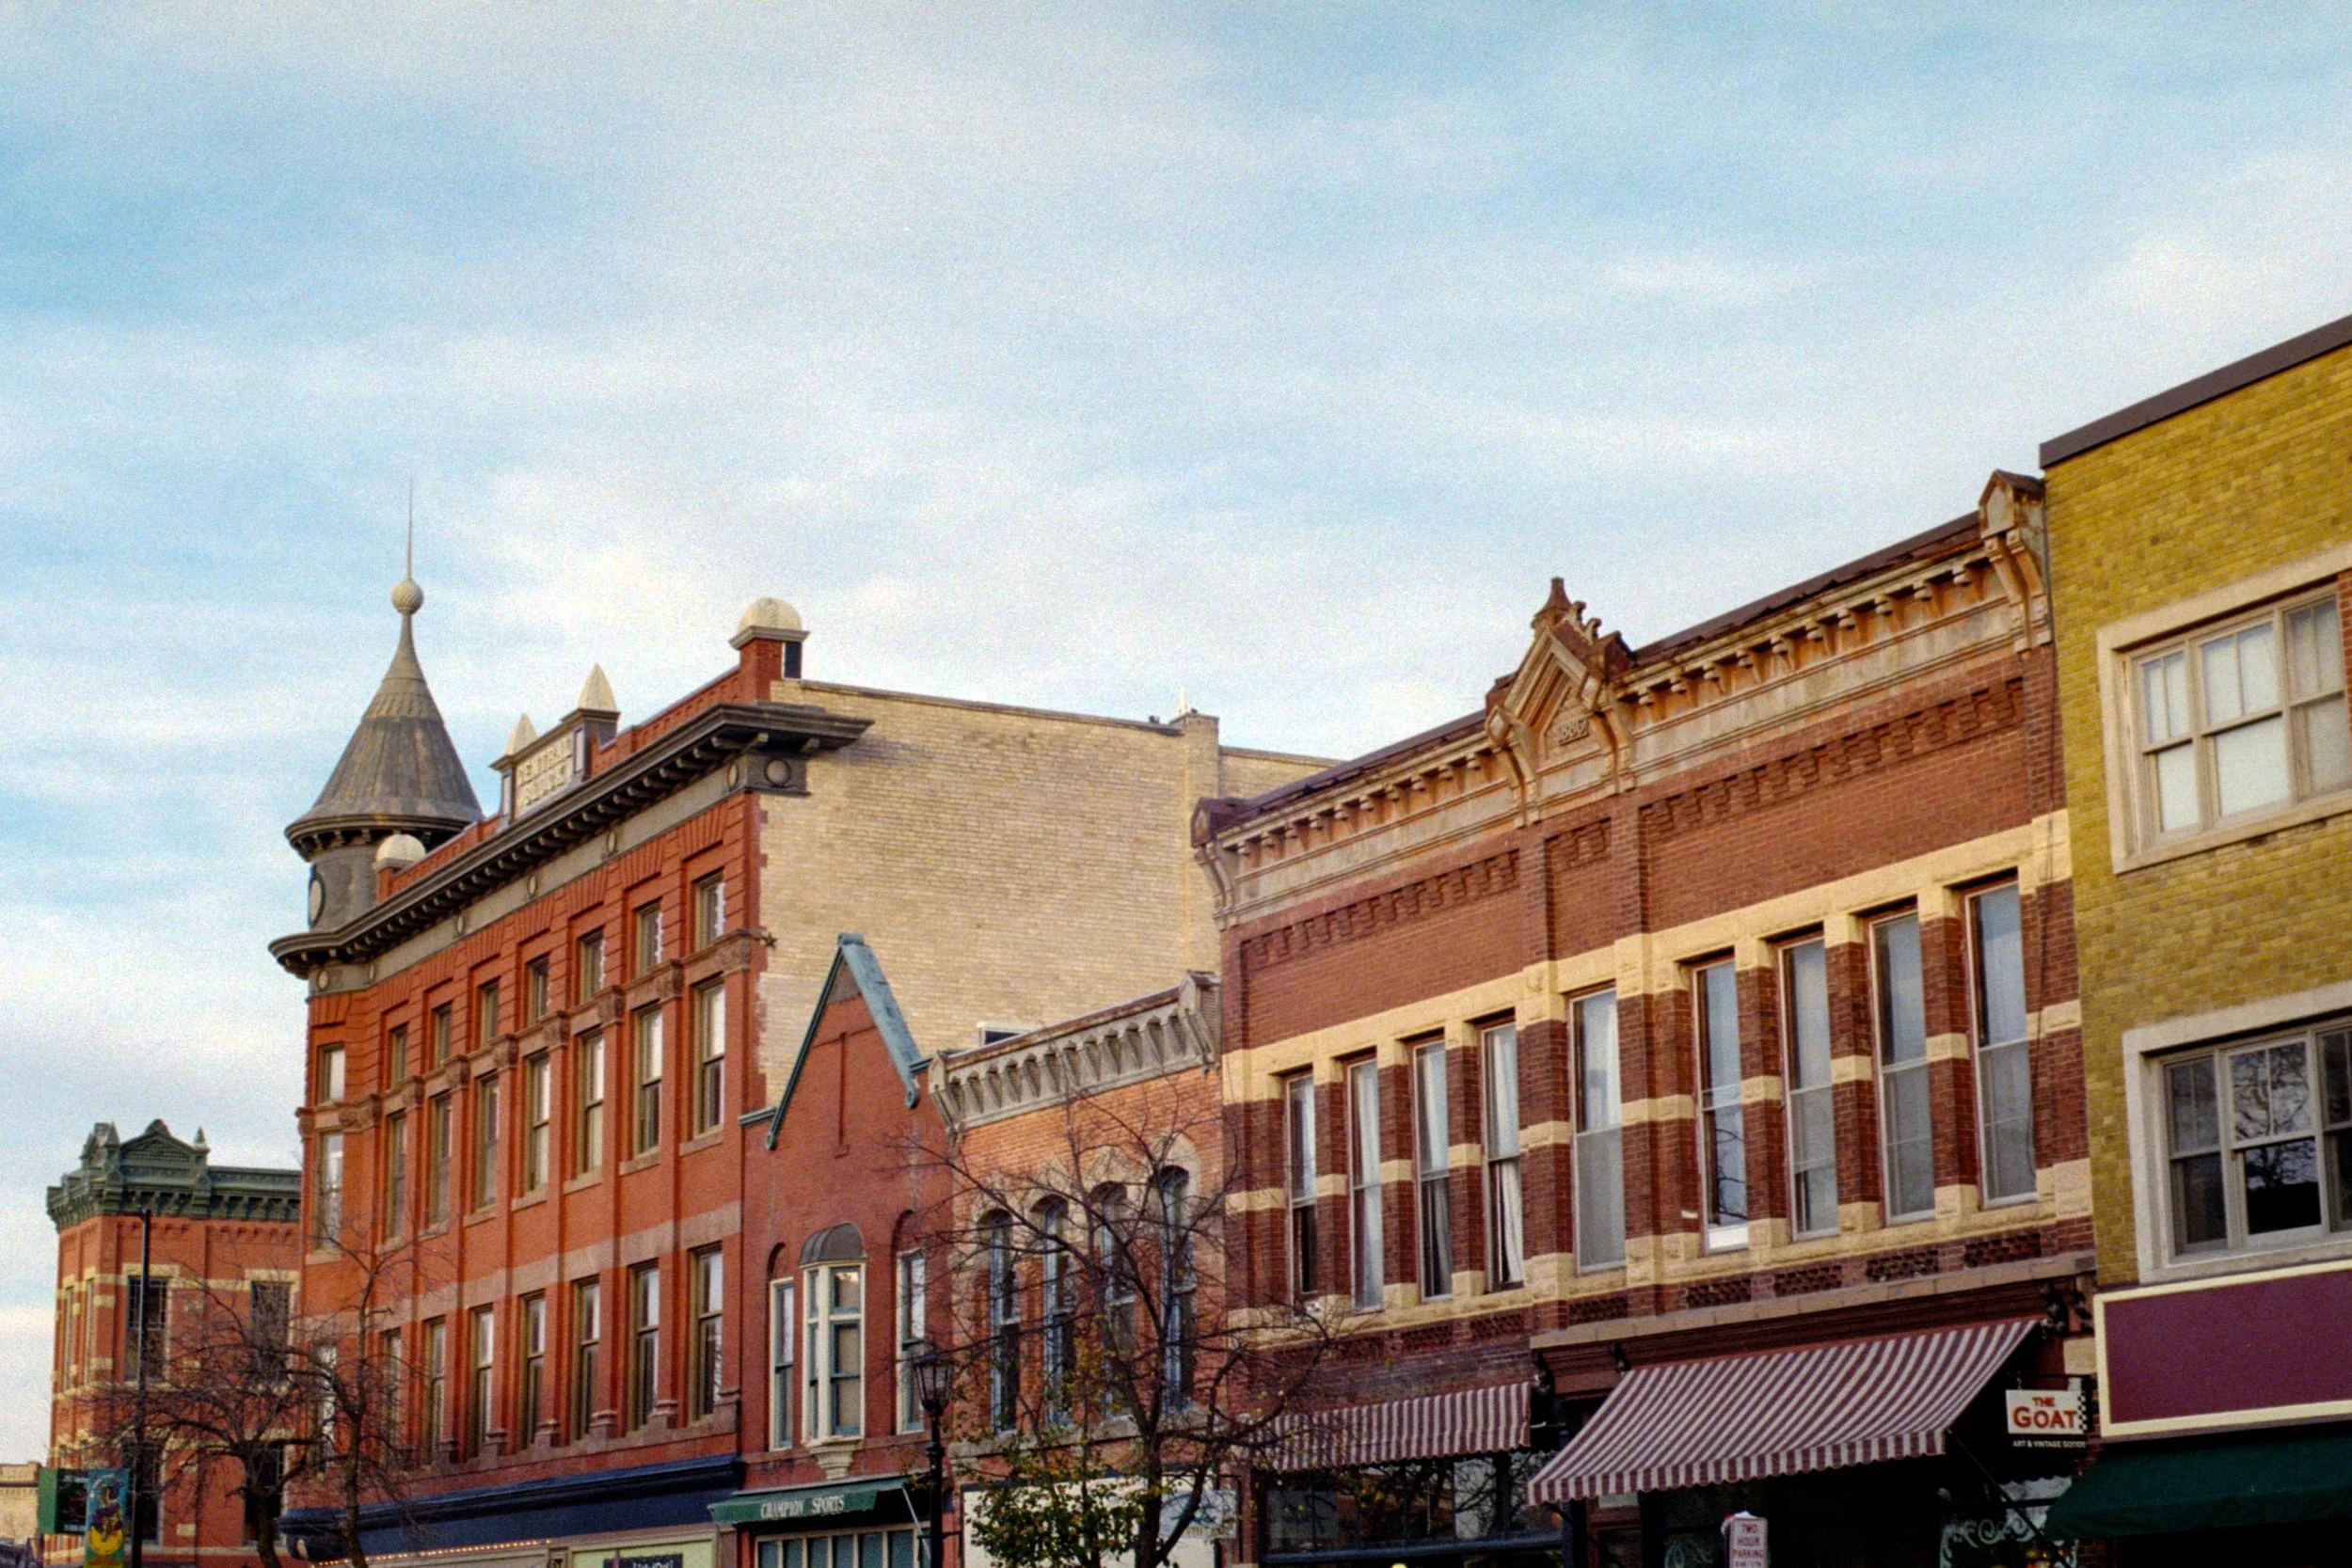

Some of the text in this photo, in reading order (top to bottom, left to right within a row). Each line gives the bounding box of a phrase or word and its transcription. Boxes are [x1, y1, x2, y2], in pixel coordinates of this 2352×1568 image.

[2032, 1397, 2056, 1407] THE
[2012, 1406, 2078, 1429] GOAT
[2026, 1439, 2033, 1449] &
[2033, 1440, 2061, 1449] VINTAGE
[2062, 1440, 2087, 1449] GOODS
[760, 1495, 845, 1519] CHAMPION SPORTS
[1741, 1524, 1758, 1534] TWO
[1737, 1536, 1761, 1547] HOUR
[1732, 1548, 1766, 1559] PARKING
